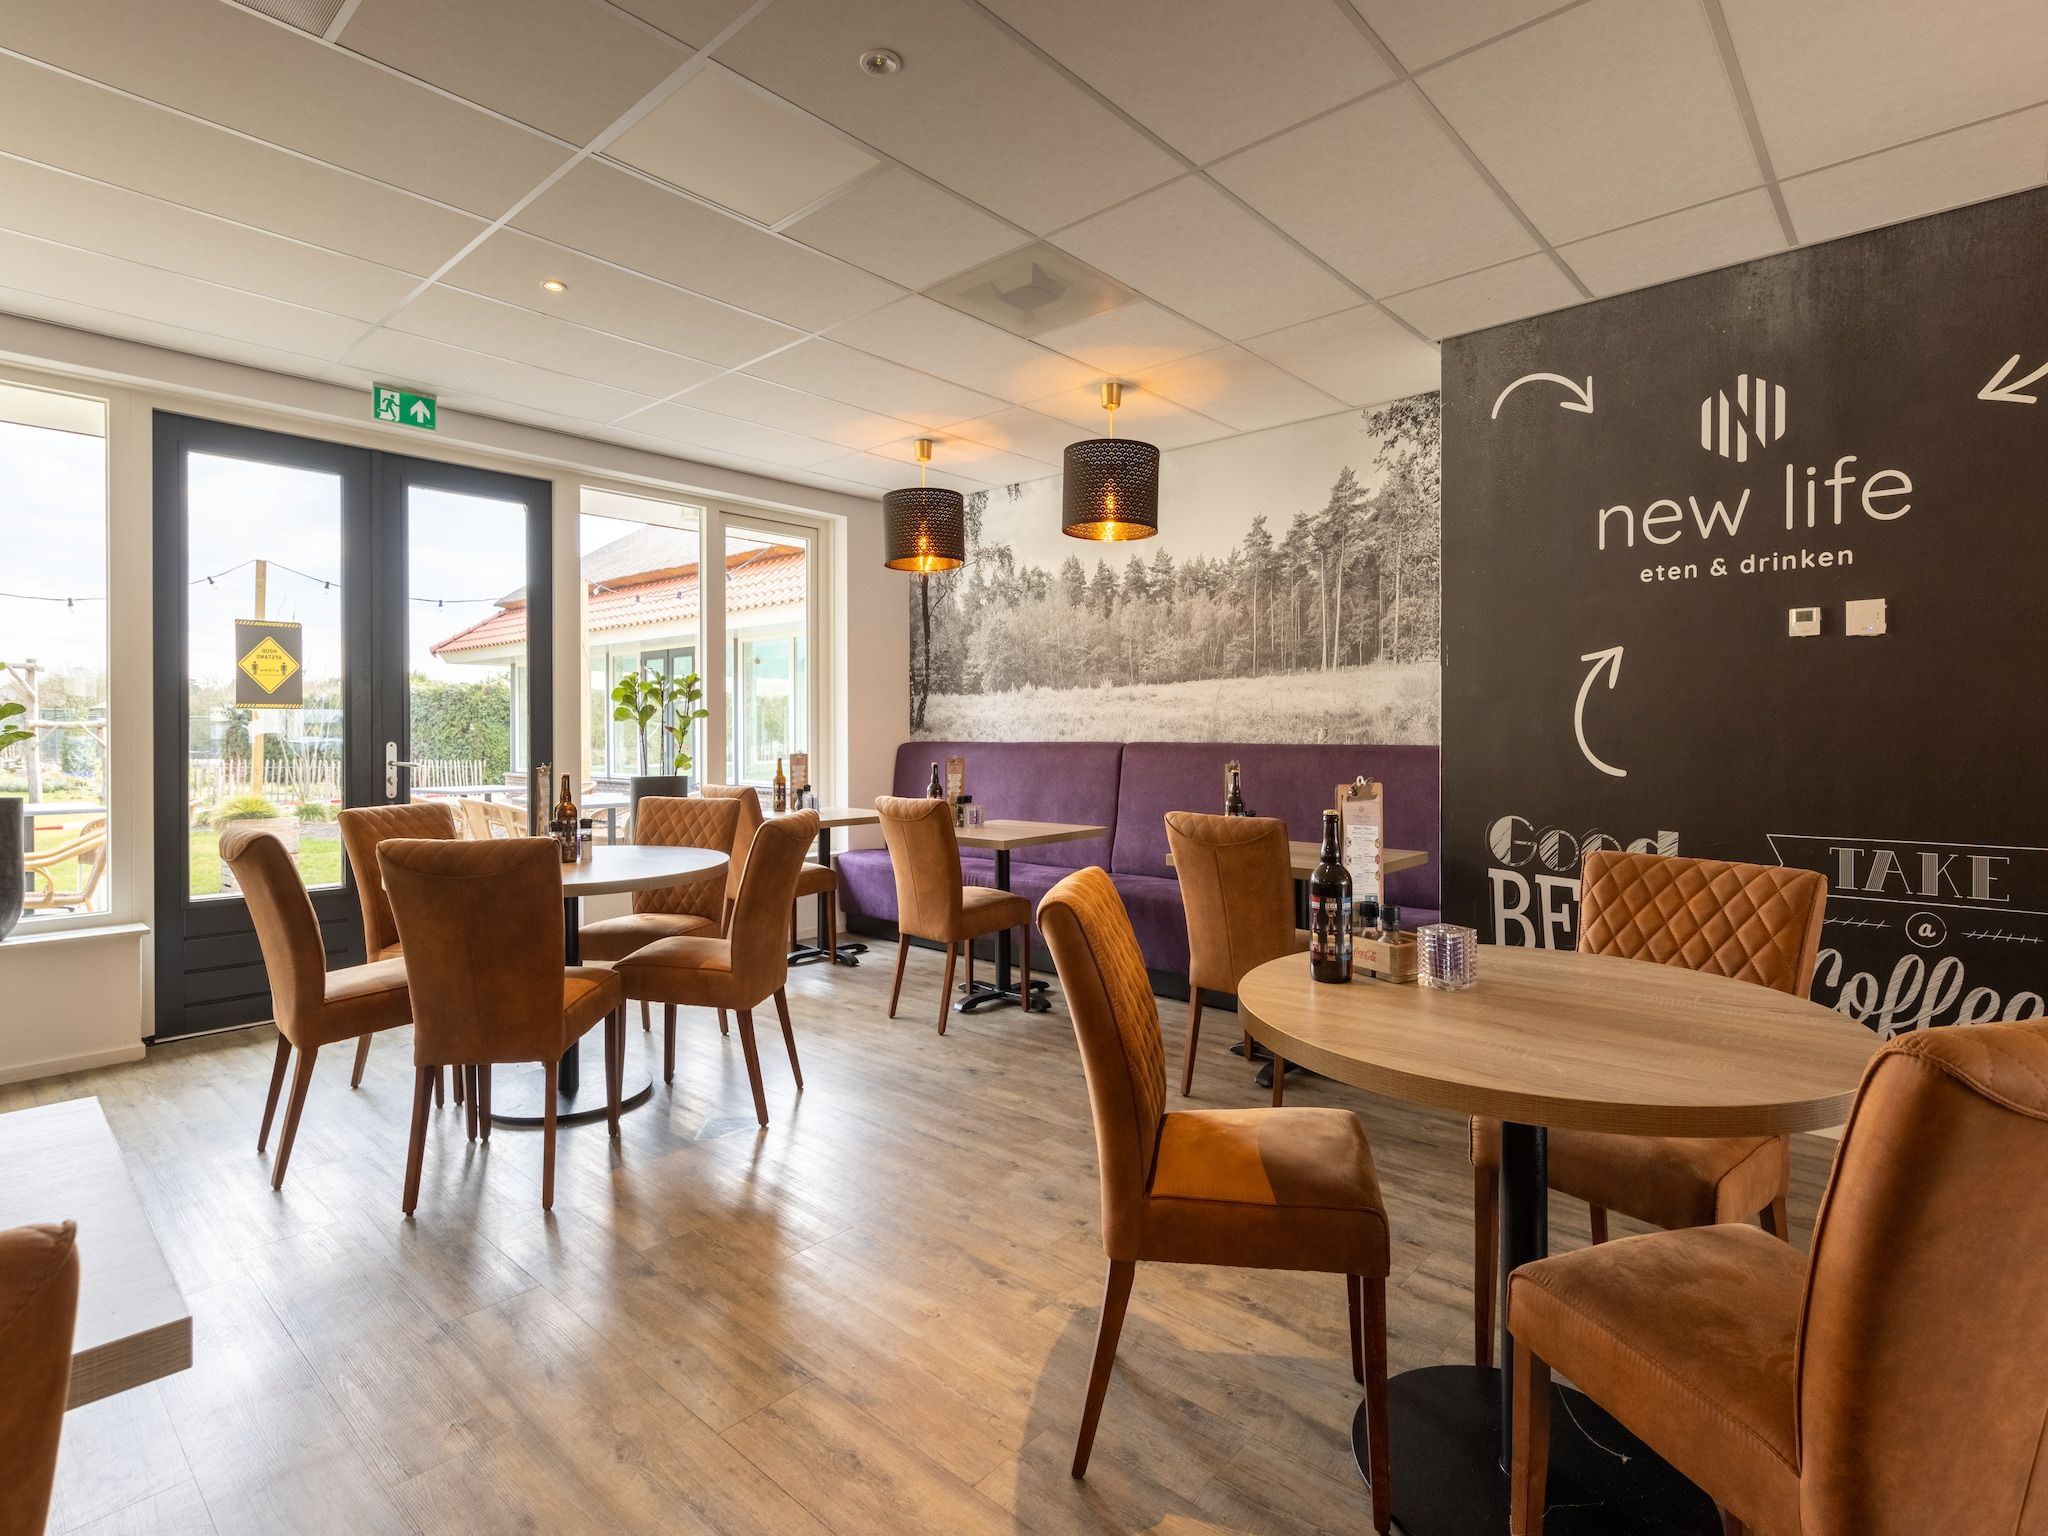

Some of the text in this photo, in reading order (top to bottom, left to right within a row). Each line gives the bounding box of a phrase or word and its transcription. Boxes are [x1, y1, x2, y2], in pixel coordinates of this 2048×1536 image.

[1598, 455, 1913, 550] new life
[1639, 548, 1854, 583] eten & drinken
[1829, 847, 2010, 902] TAKE
[1488, 868, 1581, 951] BE
[1918, 922, 1937, 938] a
